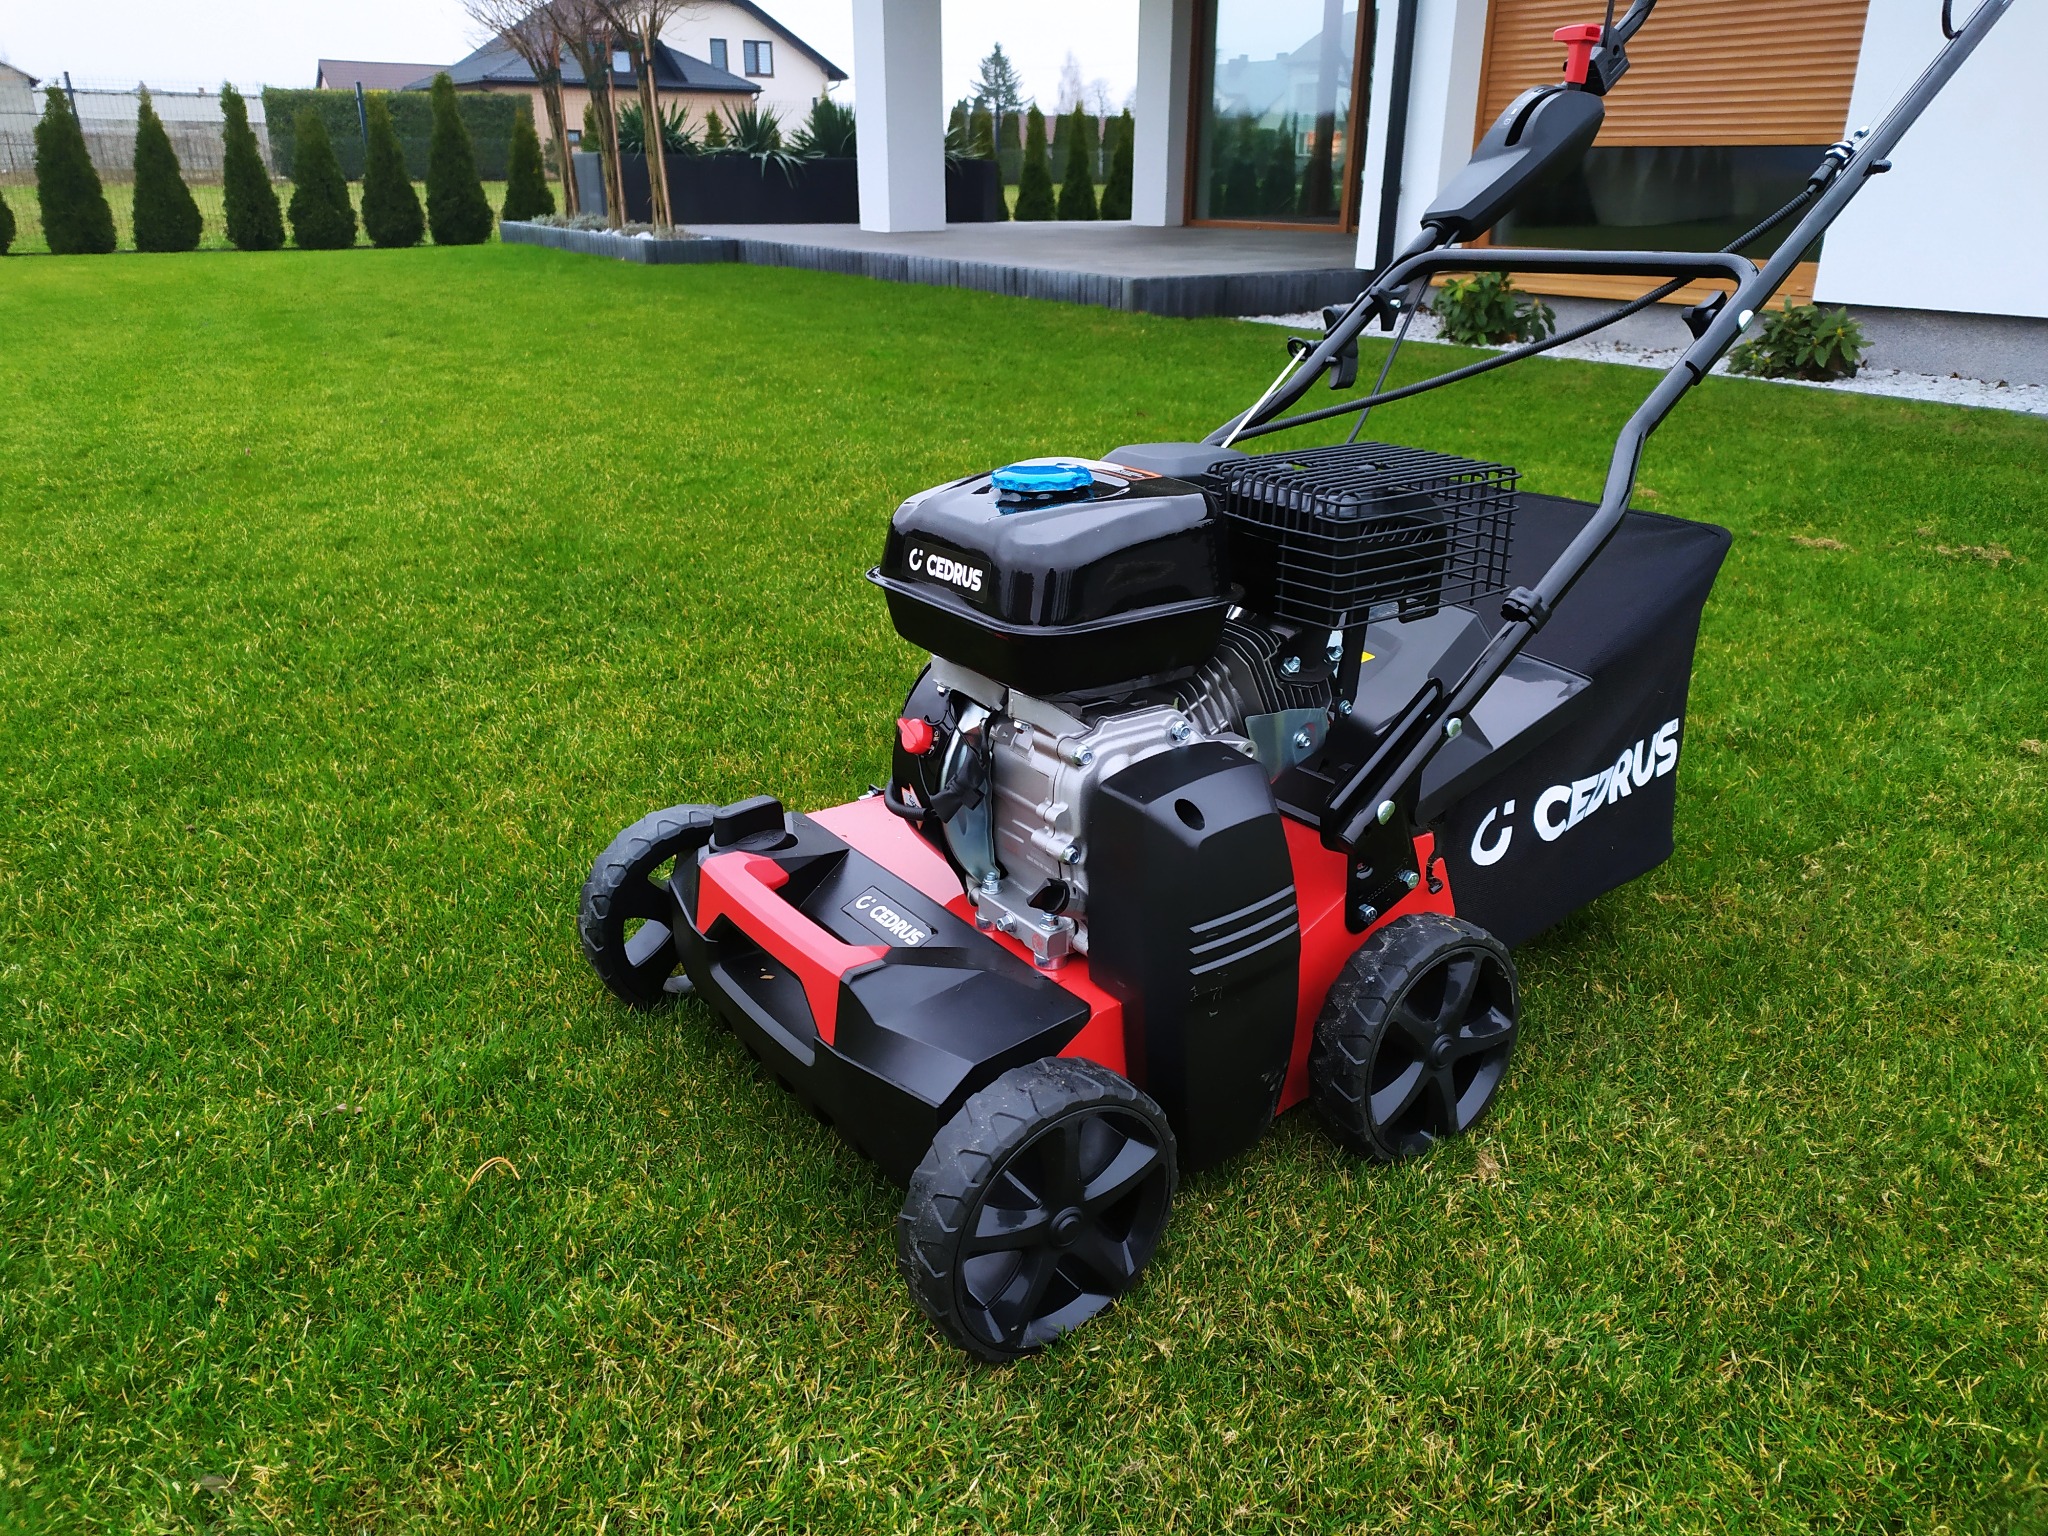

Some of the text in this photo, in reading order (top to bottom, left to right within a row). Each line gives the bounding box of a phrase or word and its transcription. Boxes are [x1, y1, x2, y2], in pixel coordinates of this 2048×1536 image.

[926, 553, 983, 592] CEDRUS
[1533, 717, 1680, 842] CEDRUS
[869, 905, 926, 946] CEDRUS
